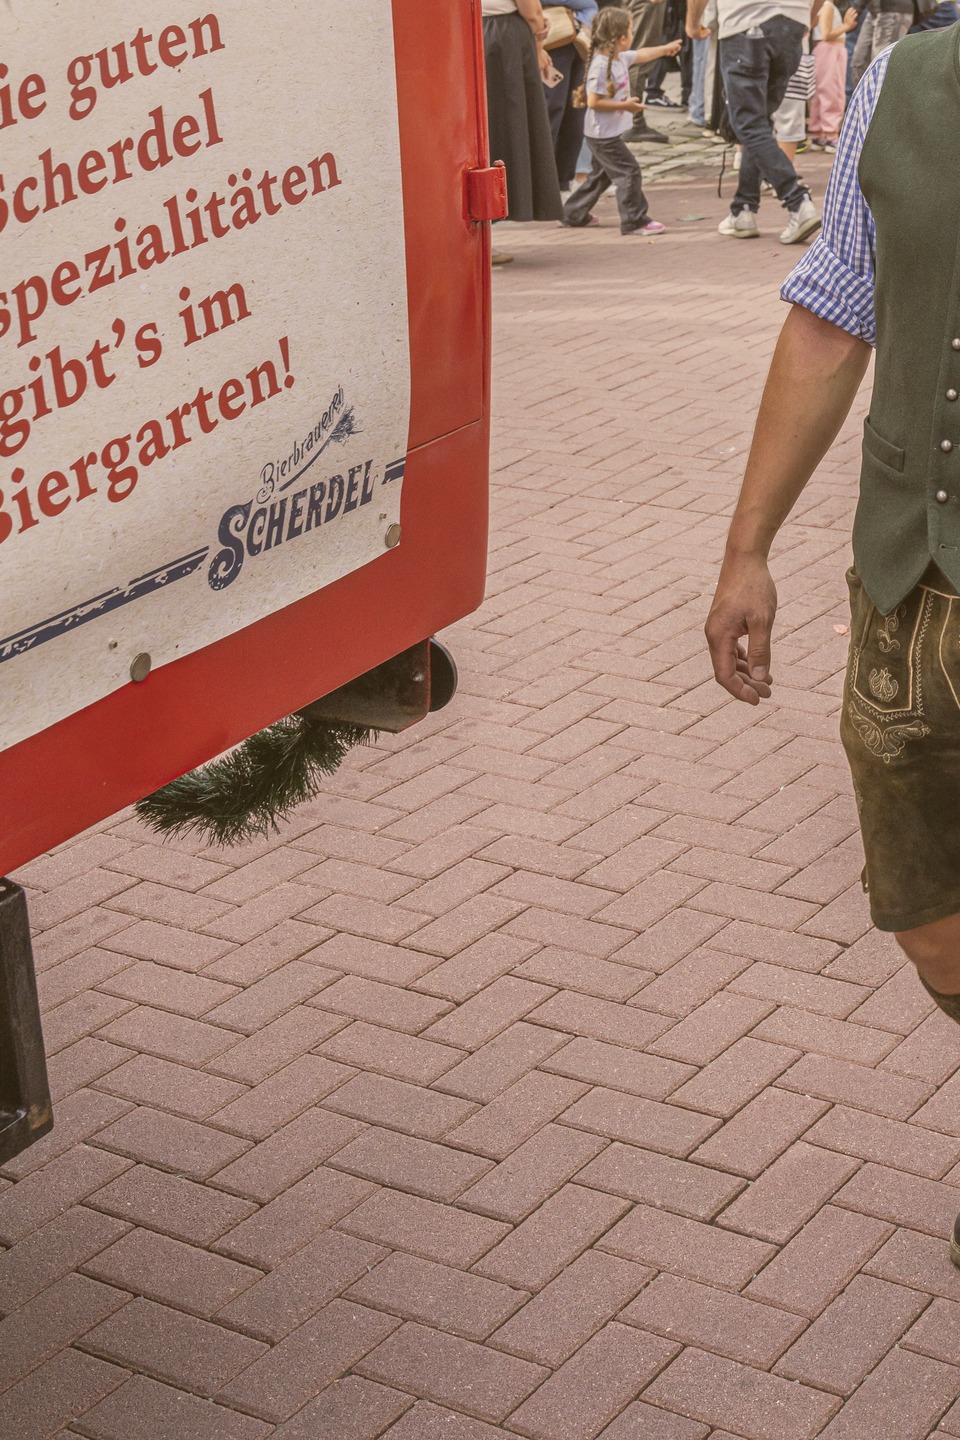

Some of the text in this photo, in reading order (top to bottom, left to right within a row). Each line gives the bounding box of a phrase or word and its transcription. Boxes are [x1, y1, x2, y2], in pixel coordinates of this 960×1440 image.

[67, 13, 226, 121] guten
[179, 282, 252, 347] im
[256, 384, 344, 504] Bierbrauerei
[208, 459, 378, 591] SCHERDEL
